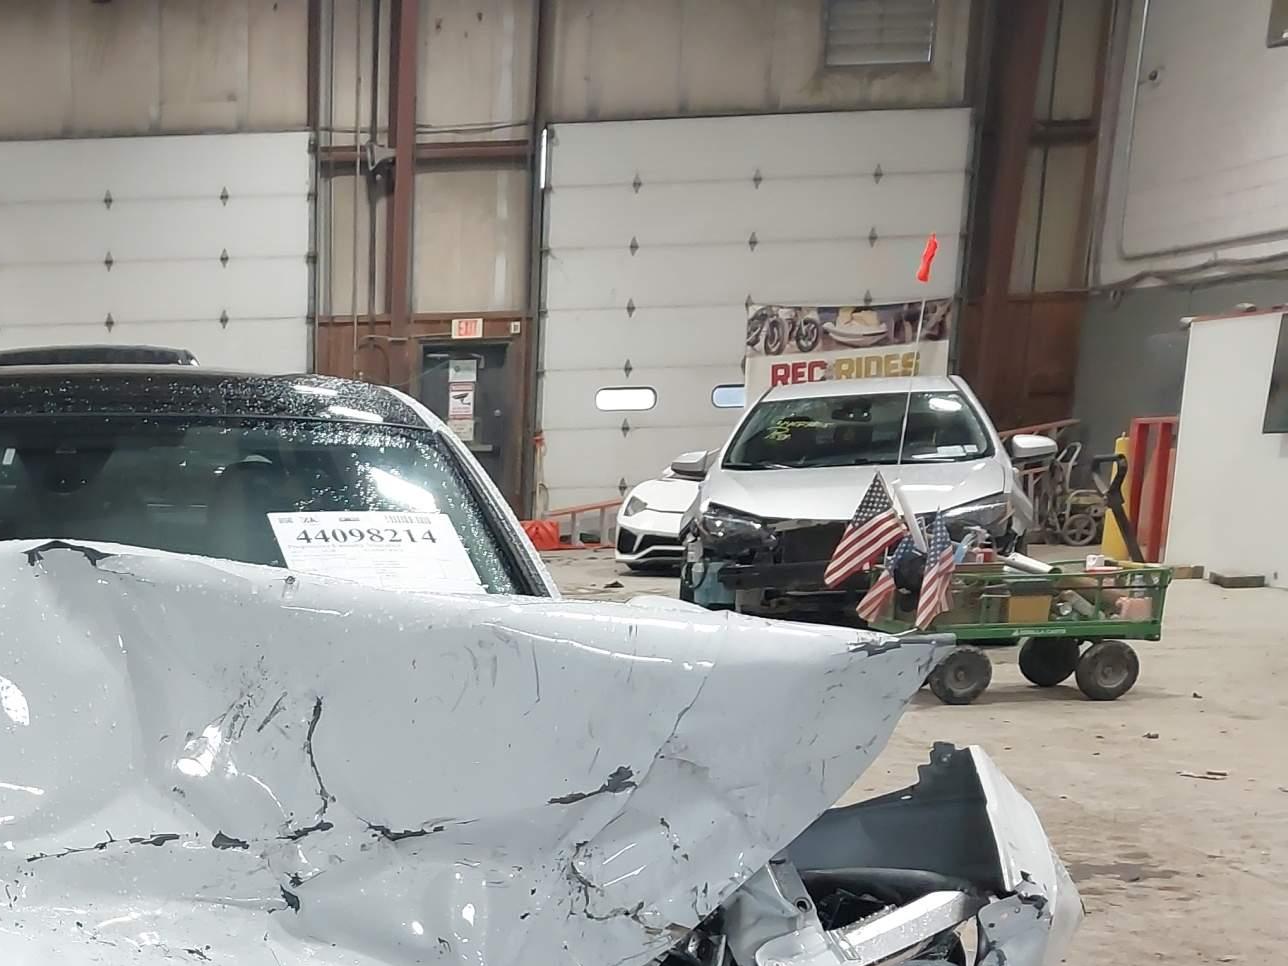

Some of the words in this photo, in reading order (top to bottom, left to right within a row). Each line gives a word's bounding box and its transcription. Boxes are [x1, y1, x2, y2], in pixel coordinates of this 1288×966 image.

[458, 319, 478, 336] EXIT
[771, 360, 828, 387] REC
[834, 351, 921, 380] RIDES
[296, 528, 437, 544] 44098214
